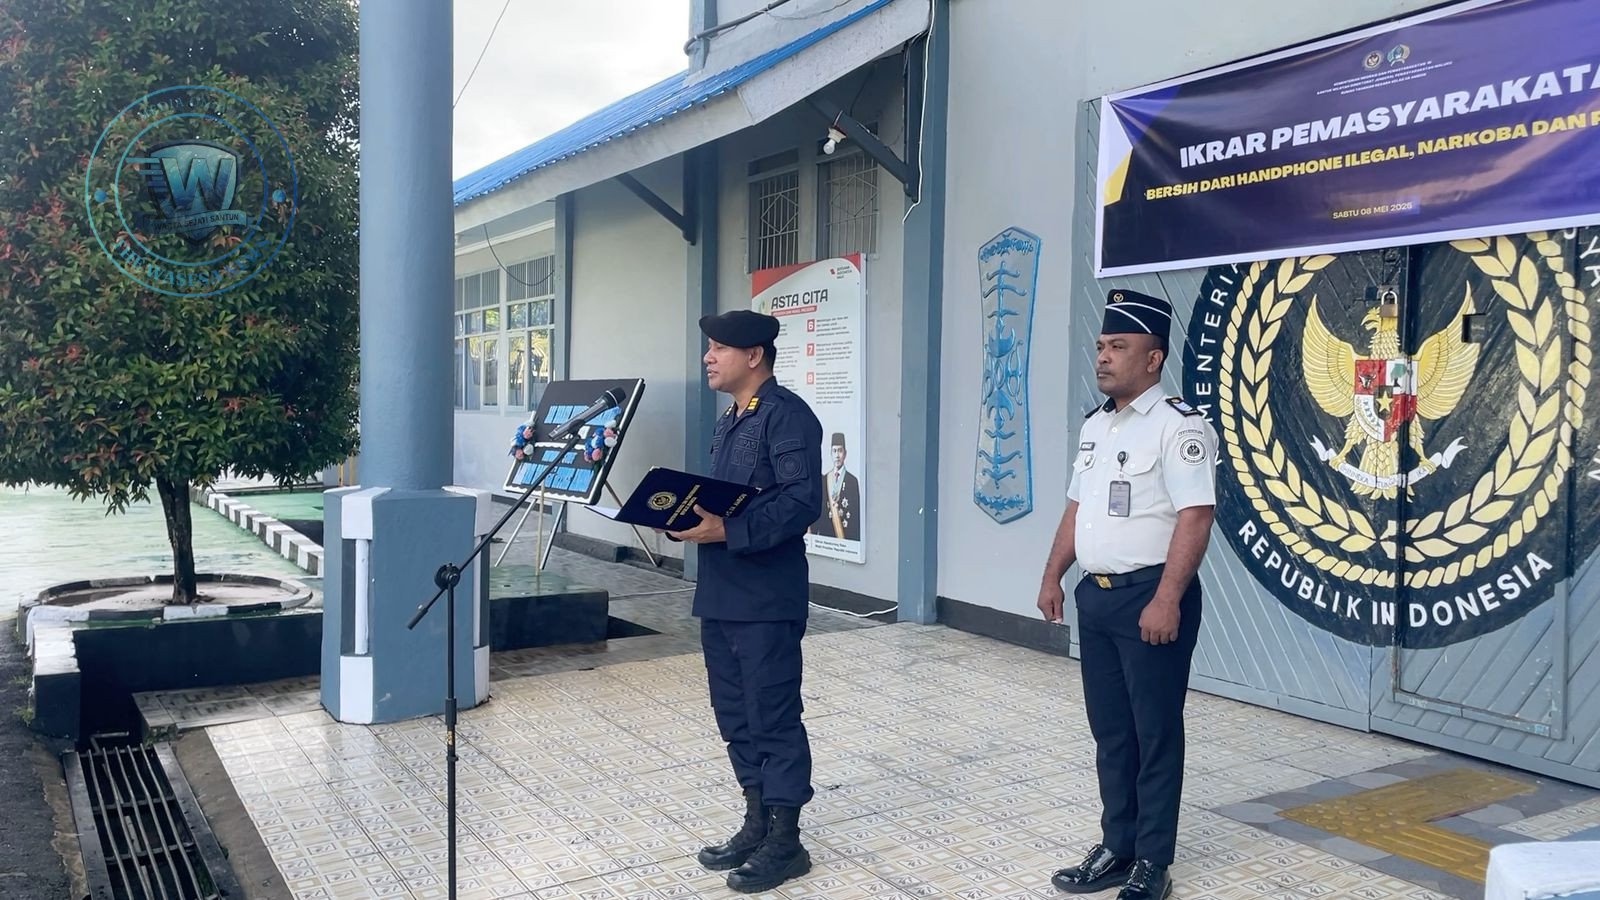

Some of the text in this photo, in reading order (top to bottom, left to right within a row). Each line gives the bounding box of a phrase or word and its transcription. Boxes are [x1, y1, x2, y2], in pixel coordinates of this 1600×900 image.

[1146, 182, 1198, 200] BERSIH
[1200, 175, 1236, 192] DARI
[1237, 156, 1342, 185] HANDPHONE
[1345, 144, 1415, 168] ILEGAL,
[1418, 123, 1528, 155] NARKOBA
[1532, 112, 1586, 135] DAN
[1179, 132, 1266, 168] IKRAR
[1332, 209, 1359, 219] SABTU
[1373, 205, 1389, 214] MEI
[771, 288, 829, 310] ASTA CITA
[807, 320, 814, 331] 6
[807, 345, 814, 355] 7
[1195, 263, 1239, 466] MENTERI
[1239, 519, 1553, 628] REPUBLIK INDONESIA
